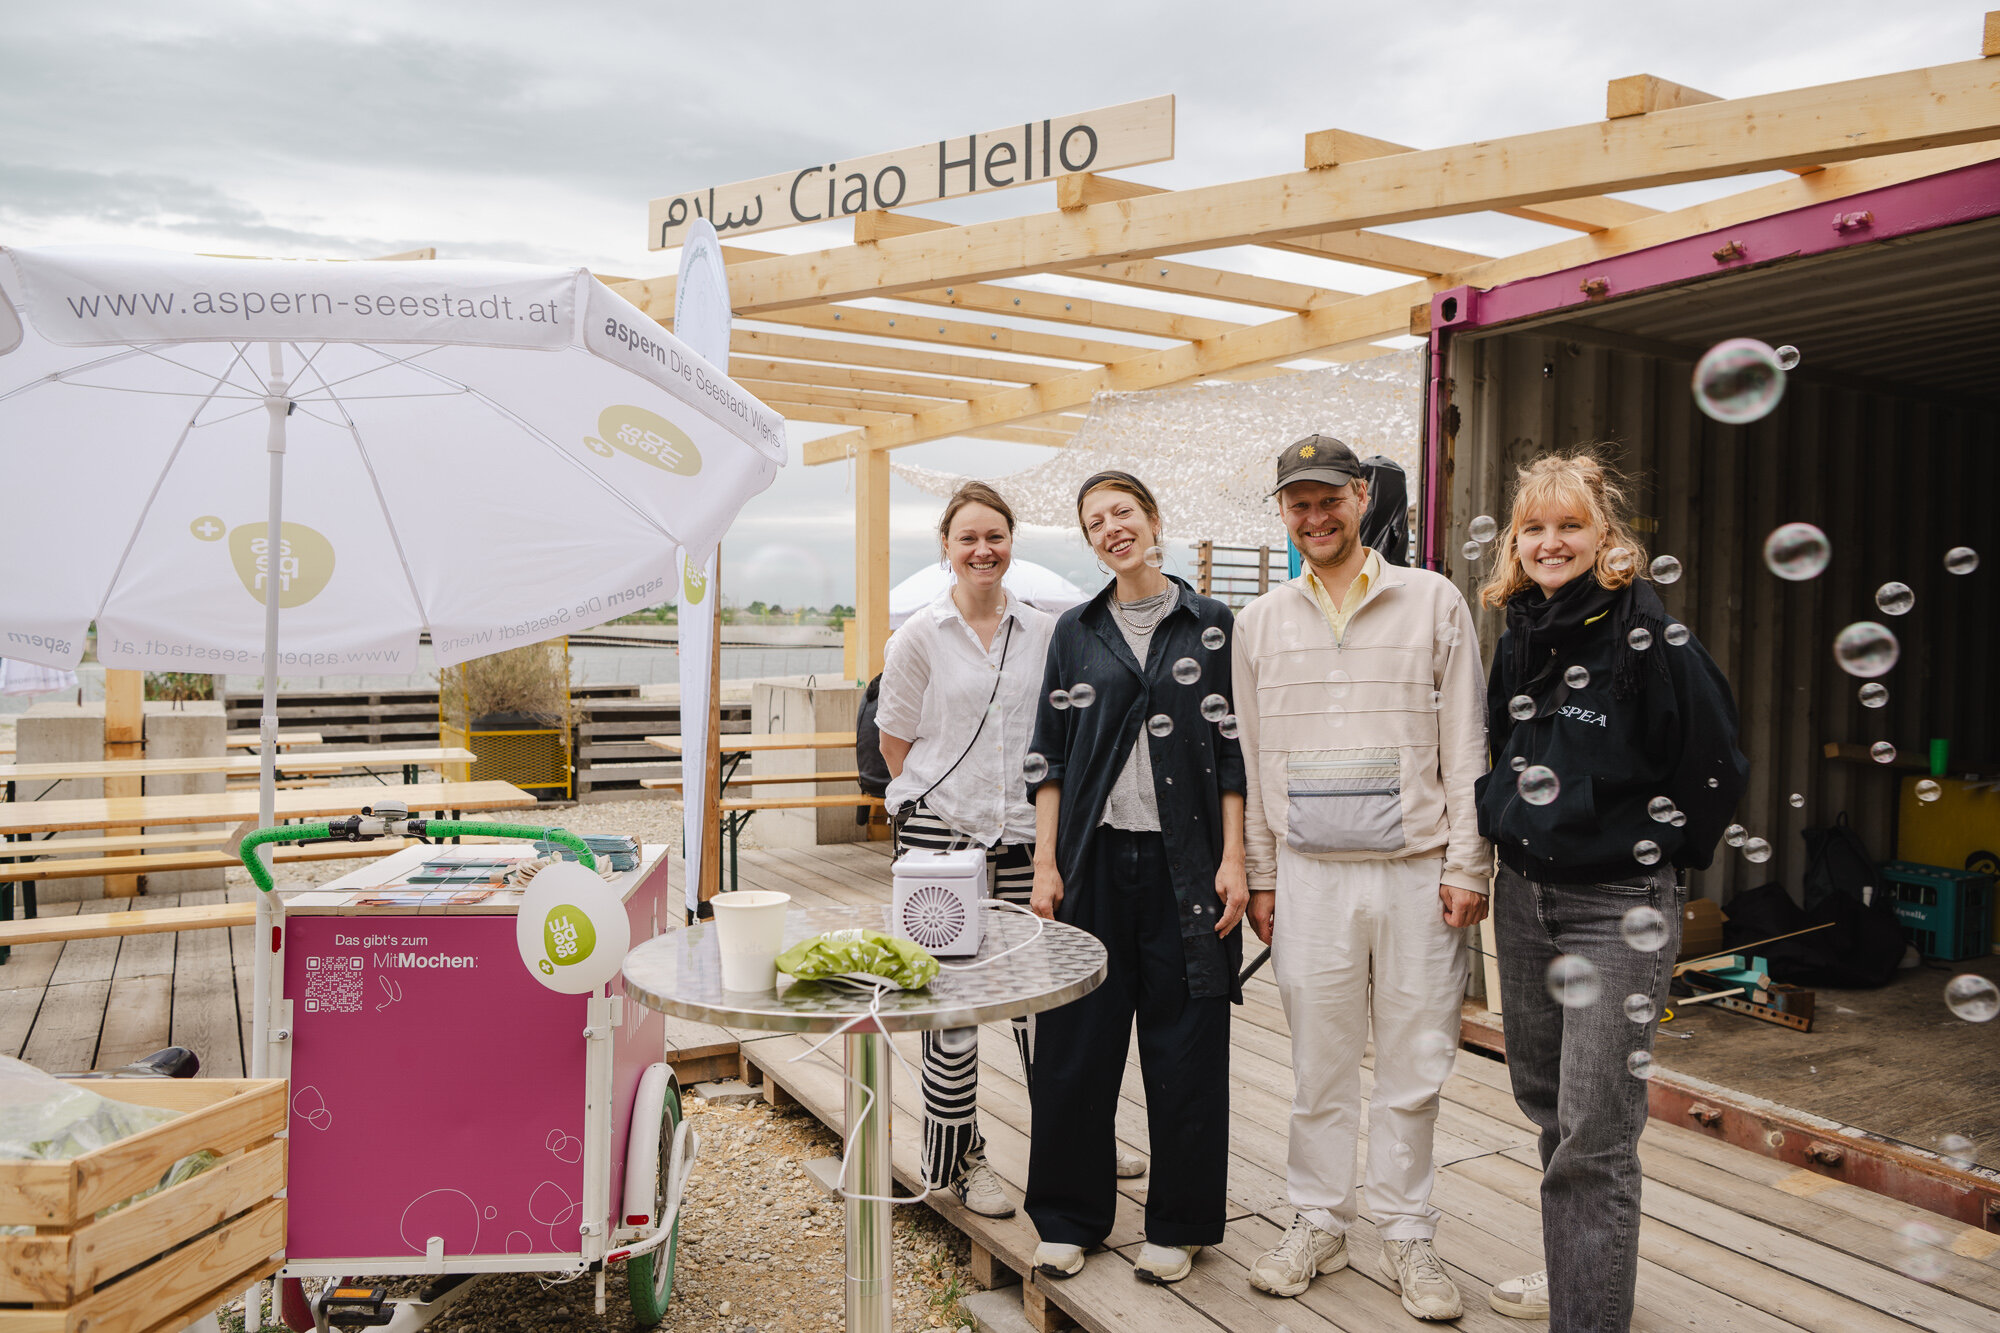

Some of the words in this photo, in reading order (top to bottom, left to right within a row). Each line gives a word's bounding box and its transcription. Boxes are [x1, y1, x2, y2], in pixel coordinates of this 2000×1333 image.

[789, 163, 907, 222] Ciao
[938, 118, 1098, 199] Hello
[661, 187, 763, 248] سلام
[66, 291, 559, 325] www.aspern-seestadt.at
[604, 317, 666, 365] aspern
[670, 349, 692, 382] Die
[695, 367, 748, 423] Seestadt
[749, 408, 781, 448] Wiens
[335, 934, 361, 947] Das
[401, 936, 429, 947] zum
[373, 952, 480, 969] MitMochen:
